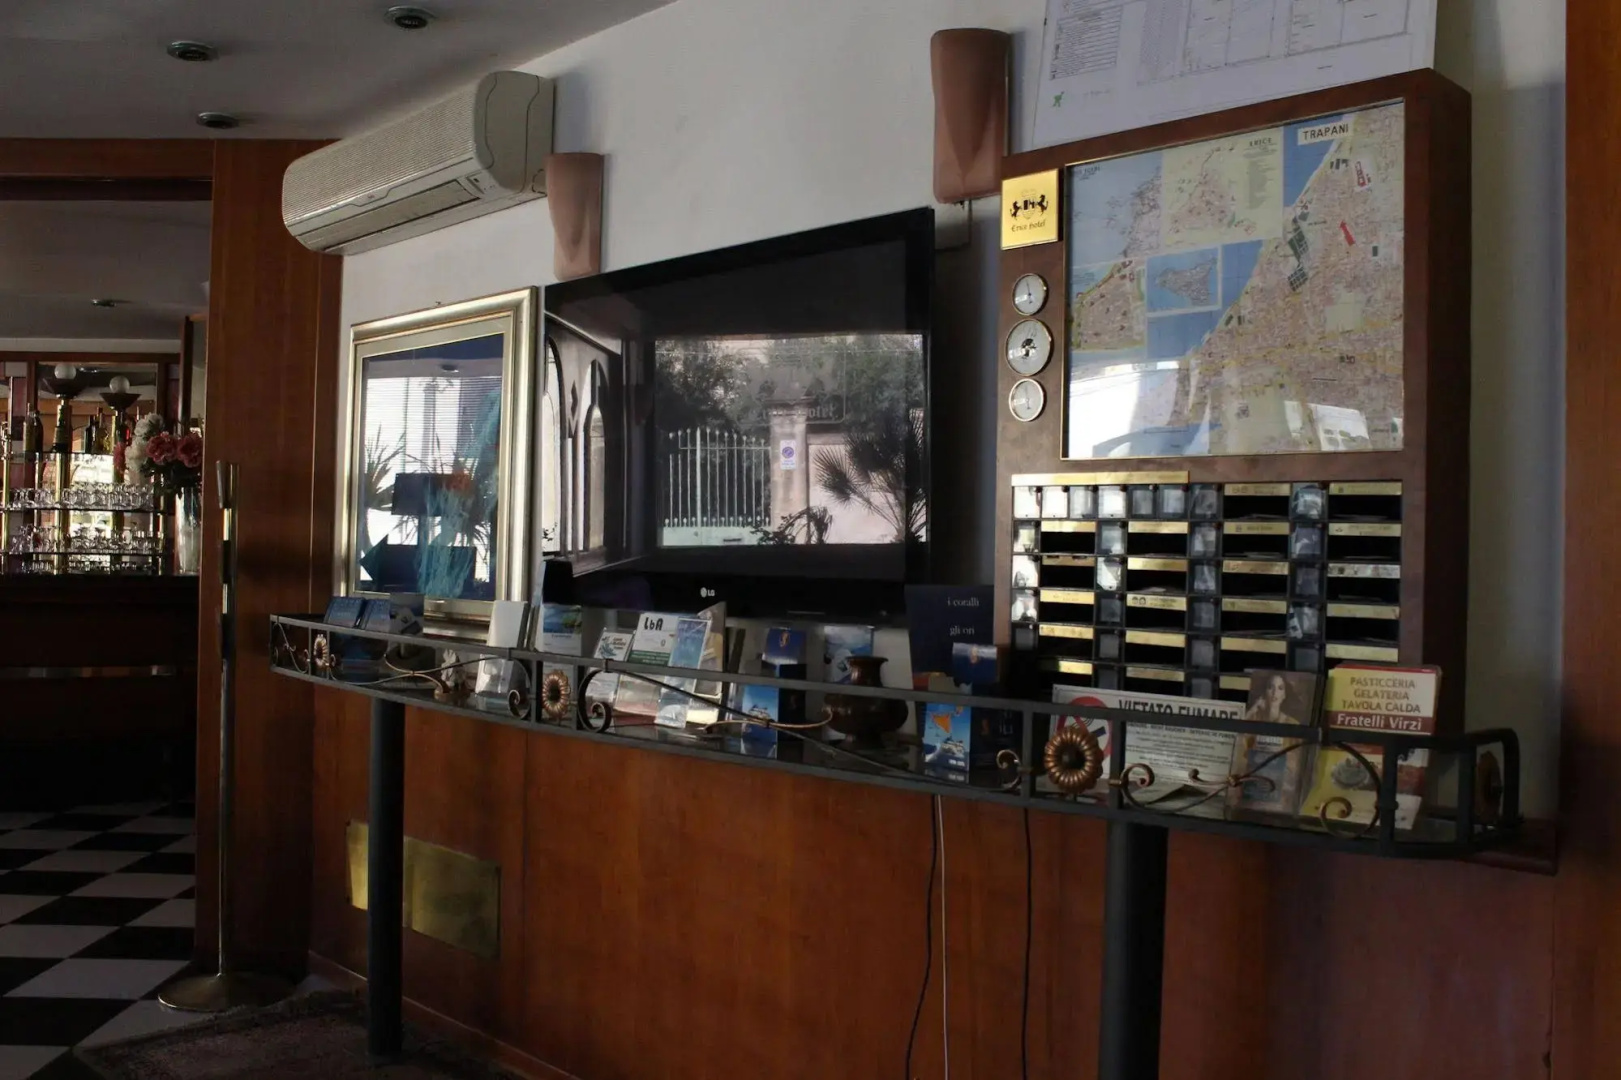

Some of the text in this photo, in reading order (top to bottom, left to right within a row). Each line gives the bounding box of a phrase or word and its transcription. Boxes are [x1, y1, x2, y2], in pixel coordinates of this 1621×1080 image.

[1302, 124, 1349, 140] TRAPANI
[1350, 677, 1415, 689] PASTICCERIA
[1353, 689, 1410, 700] GELATERIA
[1341, 699, 1421, 713] TAVOLA CALDA
[1337, 713, 1385, 728] Fratelli
